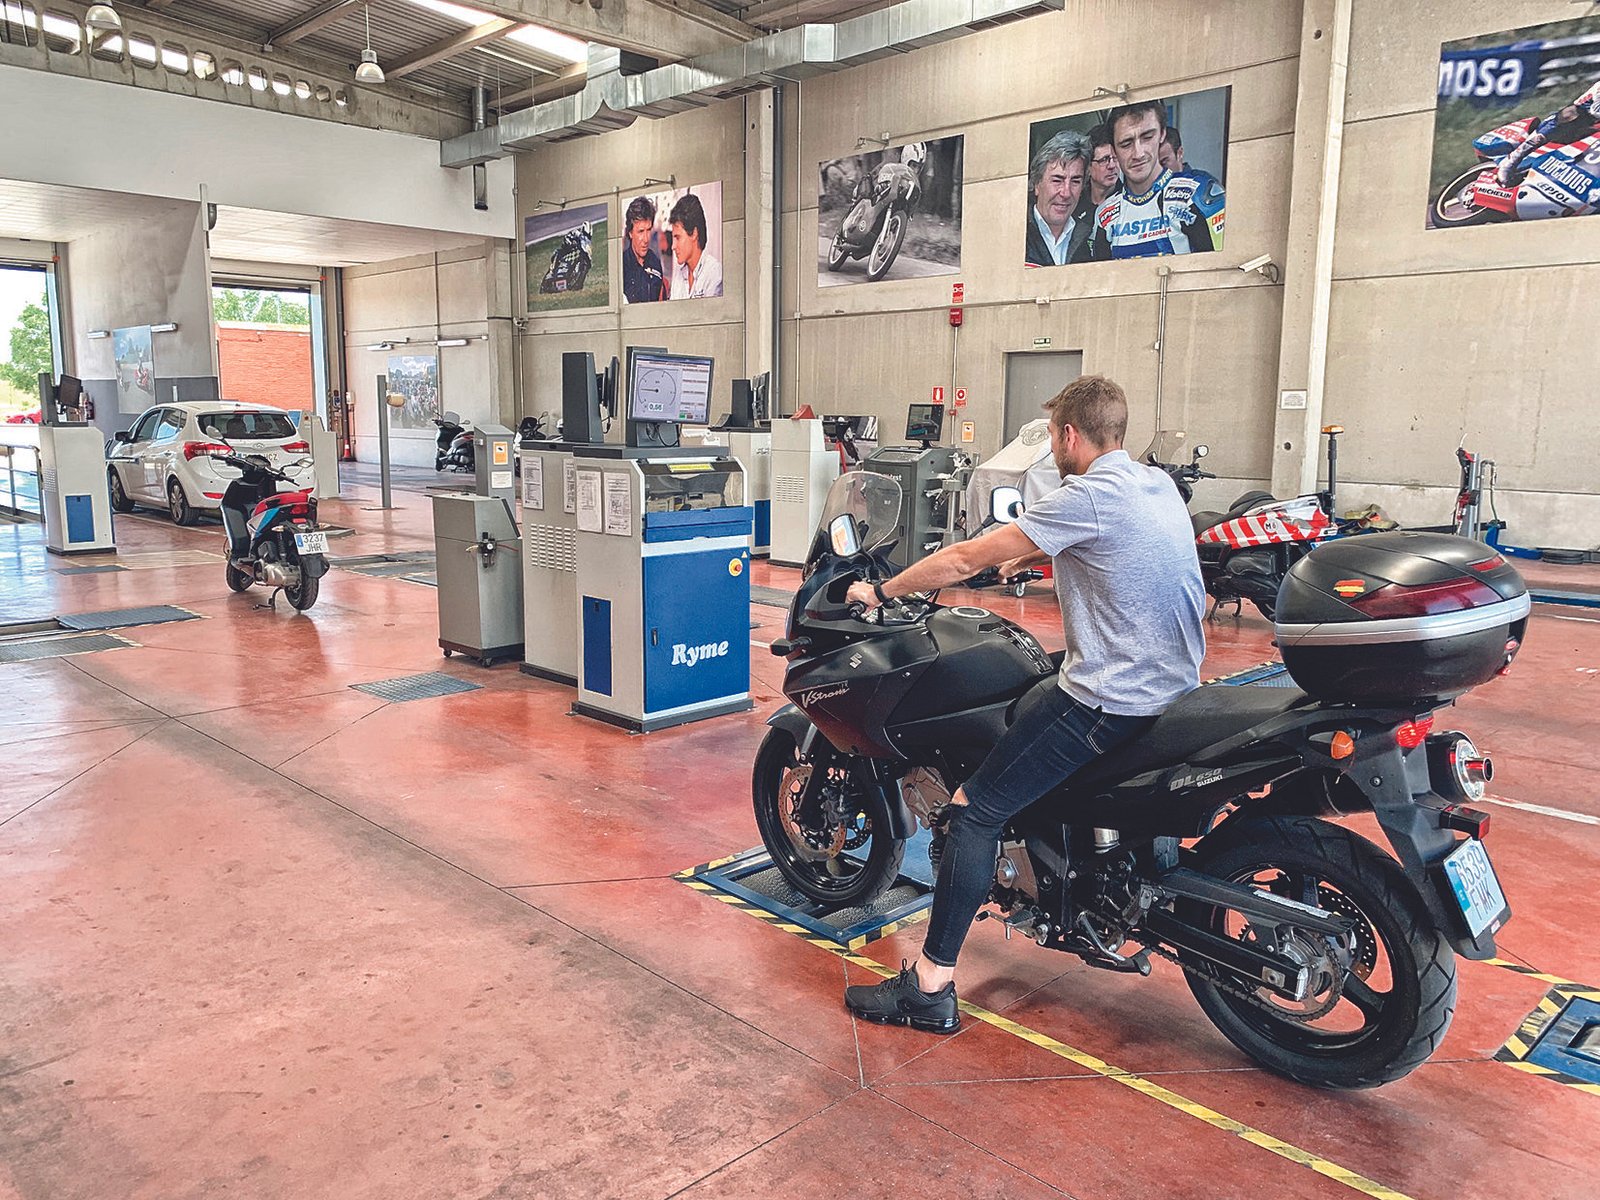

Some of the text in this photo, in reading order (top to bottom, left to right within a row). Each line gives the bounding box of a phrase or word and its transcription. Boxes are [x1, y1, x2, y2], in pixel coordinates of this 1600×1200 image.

[1538, 155, 1593, 195] DUCADOS
[1478, 187, 1512, 200] MICHELIN
[302, 533, 324, 543] 3237
[306, 543, 322, 552] JHR
[671, 640, 729, 667] Ryme
[1197, 775, 1223, 787] SUZUKI
[1470, 877, 1497, 920] FMK
